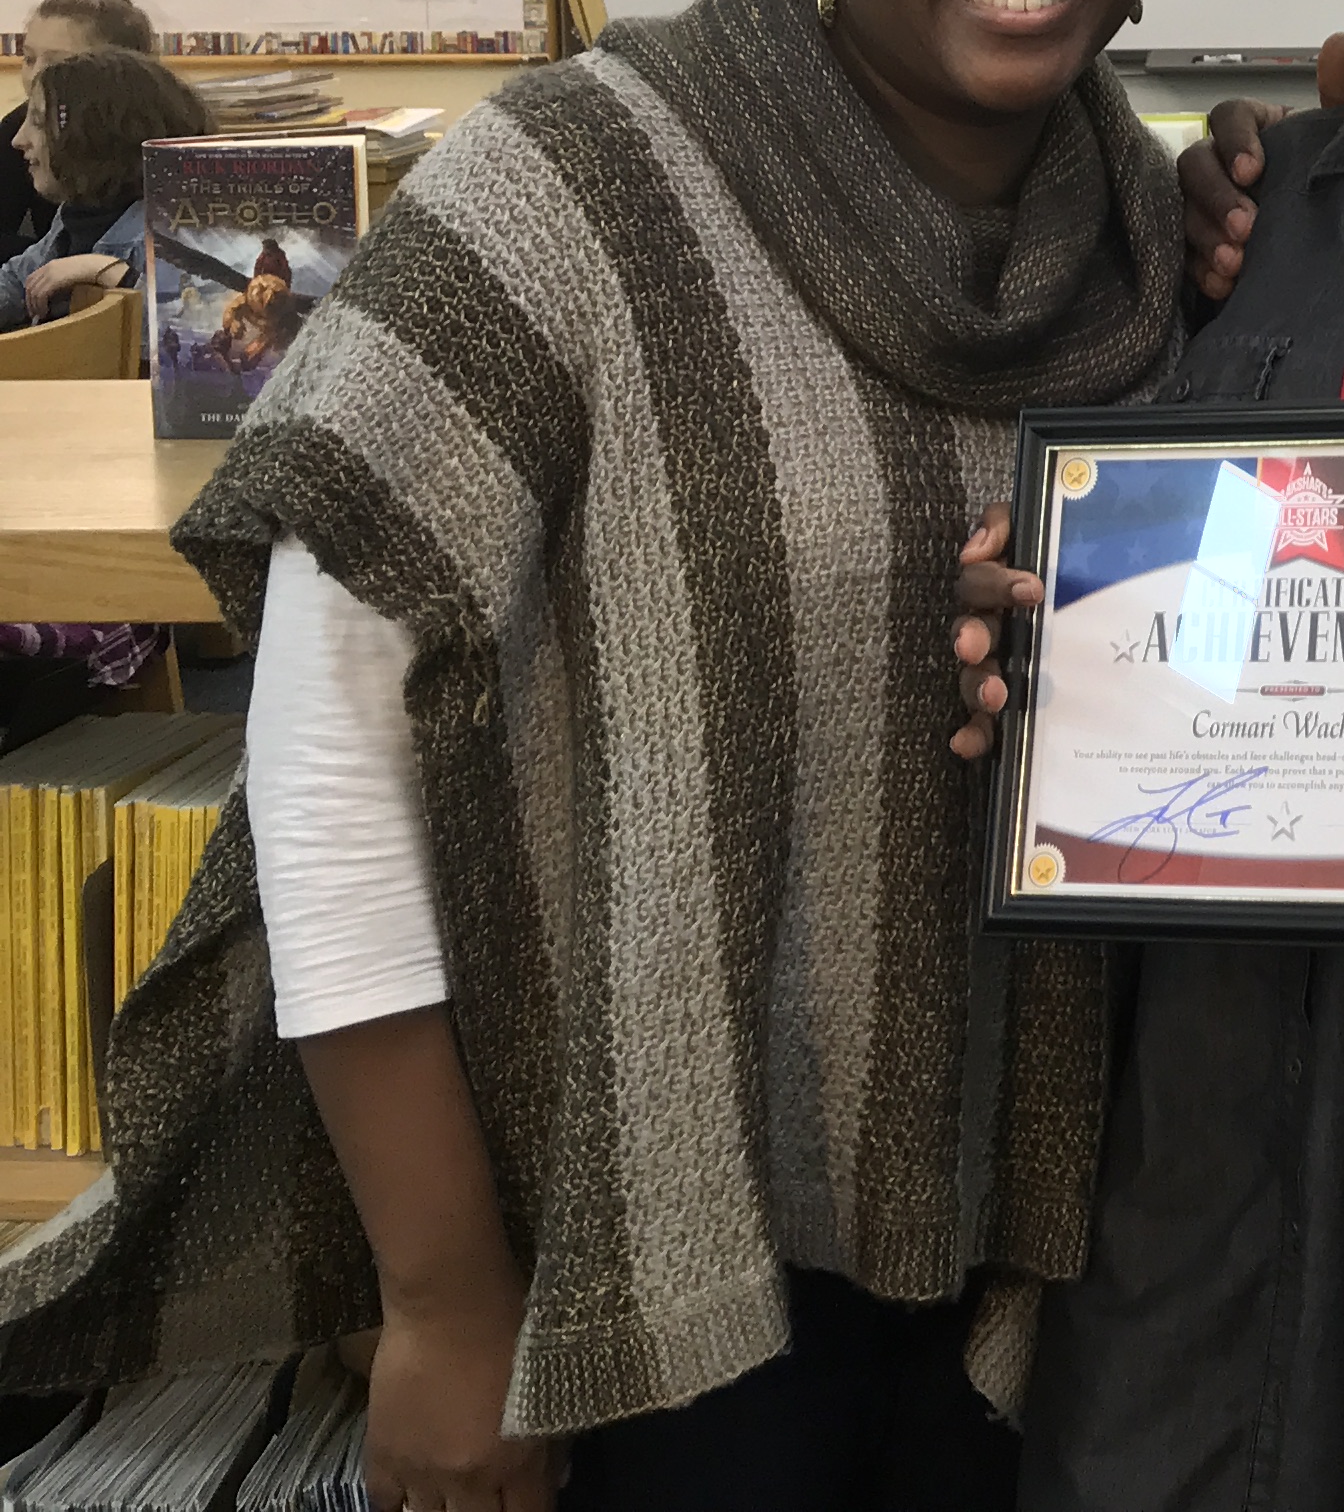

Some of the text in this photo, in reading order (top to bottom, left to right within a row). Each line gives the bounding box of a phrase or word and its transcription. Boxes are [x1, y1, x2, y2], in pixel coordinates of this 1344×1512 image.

[190, 182, 311, 194] THE TRIALS OF
[169, 198, 339, 234] APOLLO
[200, 413, 221, 422] THE
[1278, 507, 1339, 526] LL-STARS
[1192, 709, 1276, 739] Cormari
[1073, 749, 1093, 759] Your
[1096, 750, 1122, 761] ability
[1150, 751, 1167, 762] past
[1191, 750, 1229, 761] obstacles
[1231, 751, 1247, 761] and
[1269, 750, 1314, 764] challenges
[1130, 766, 1167, 775] everyone
[1170, 764, 1201, 774] around
[1282, 767, 1306, 777] prove
[1309, 766, 1326, 776] that
[1277, 779, 1326, 792] accomplish
[1328, 782, 1344, 792] any
